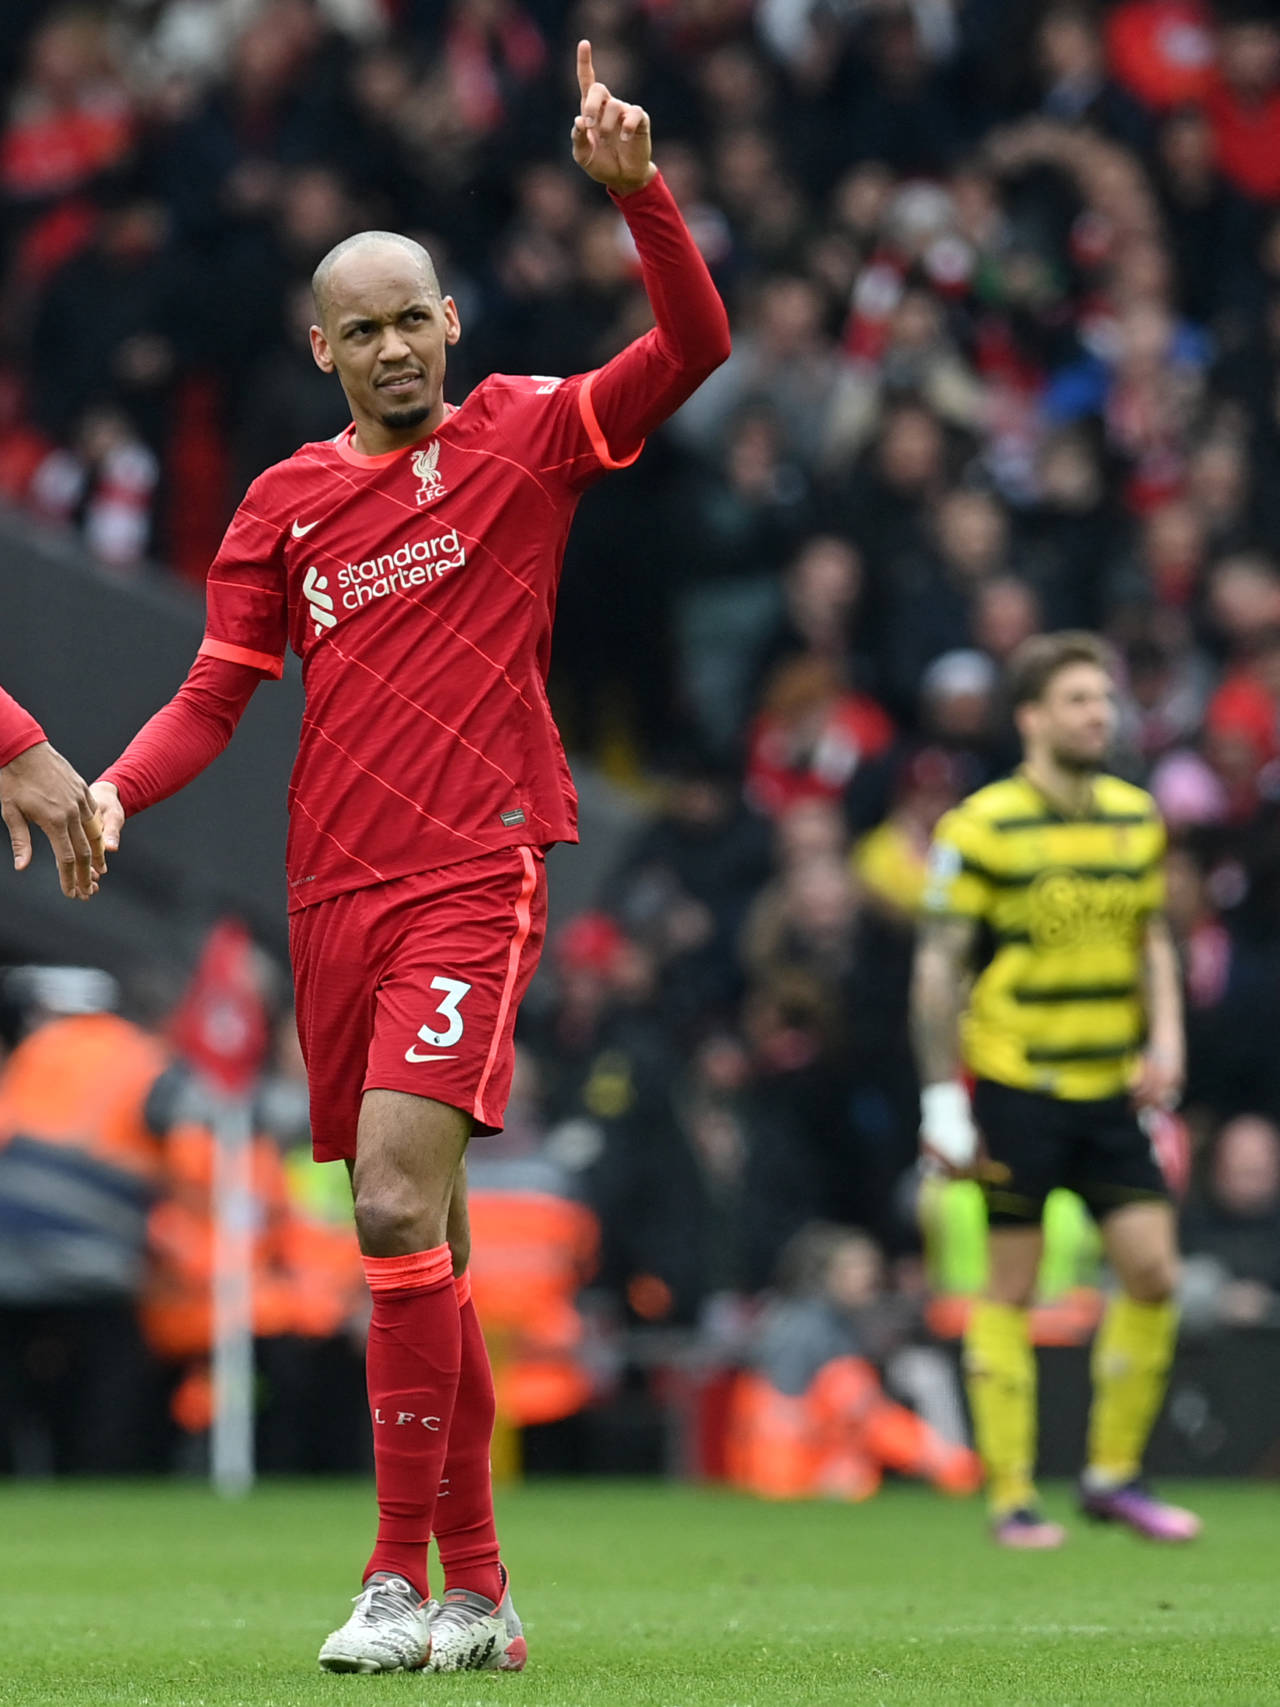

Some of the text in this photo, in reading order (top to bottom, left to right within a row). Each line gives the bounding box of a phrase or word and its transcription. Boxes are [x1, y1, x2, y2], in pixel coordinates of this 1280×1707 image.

[337, 528, 459, 588] standard
[342, 546, 466, 609] chartered
[417, 975, 472, 1047] 3
